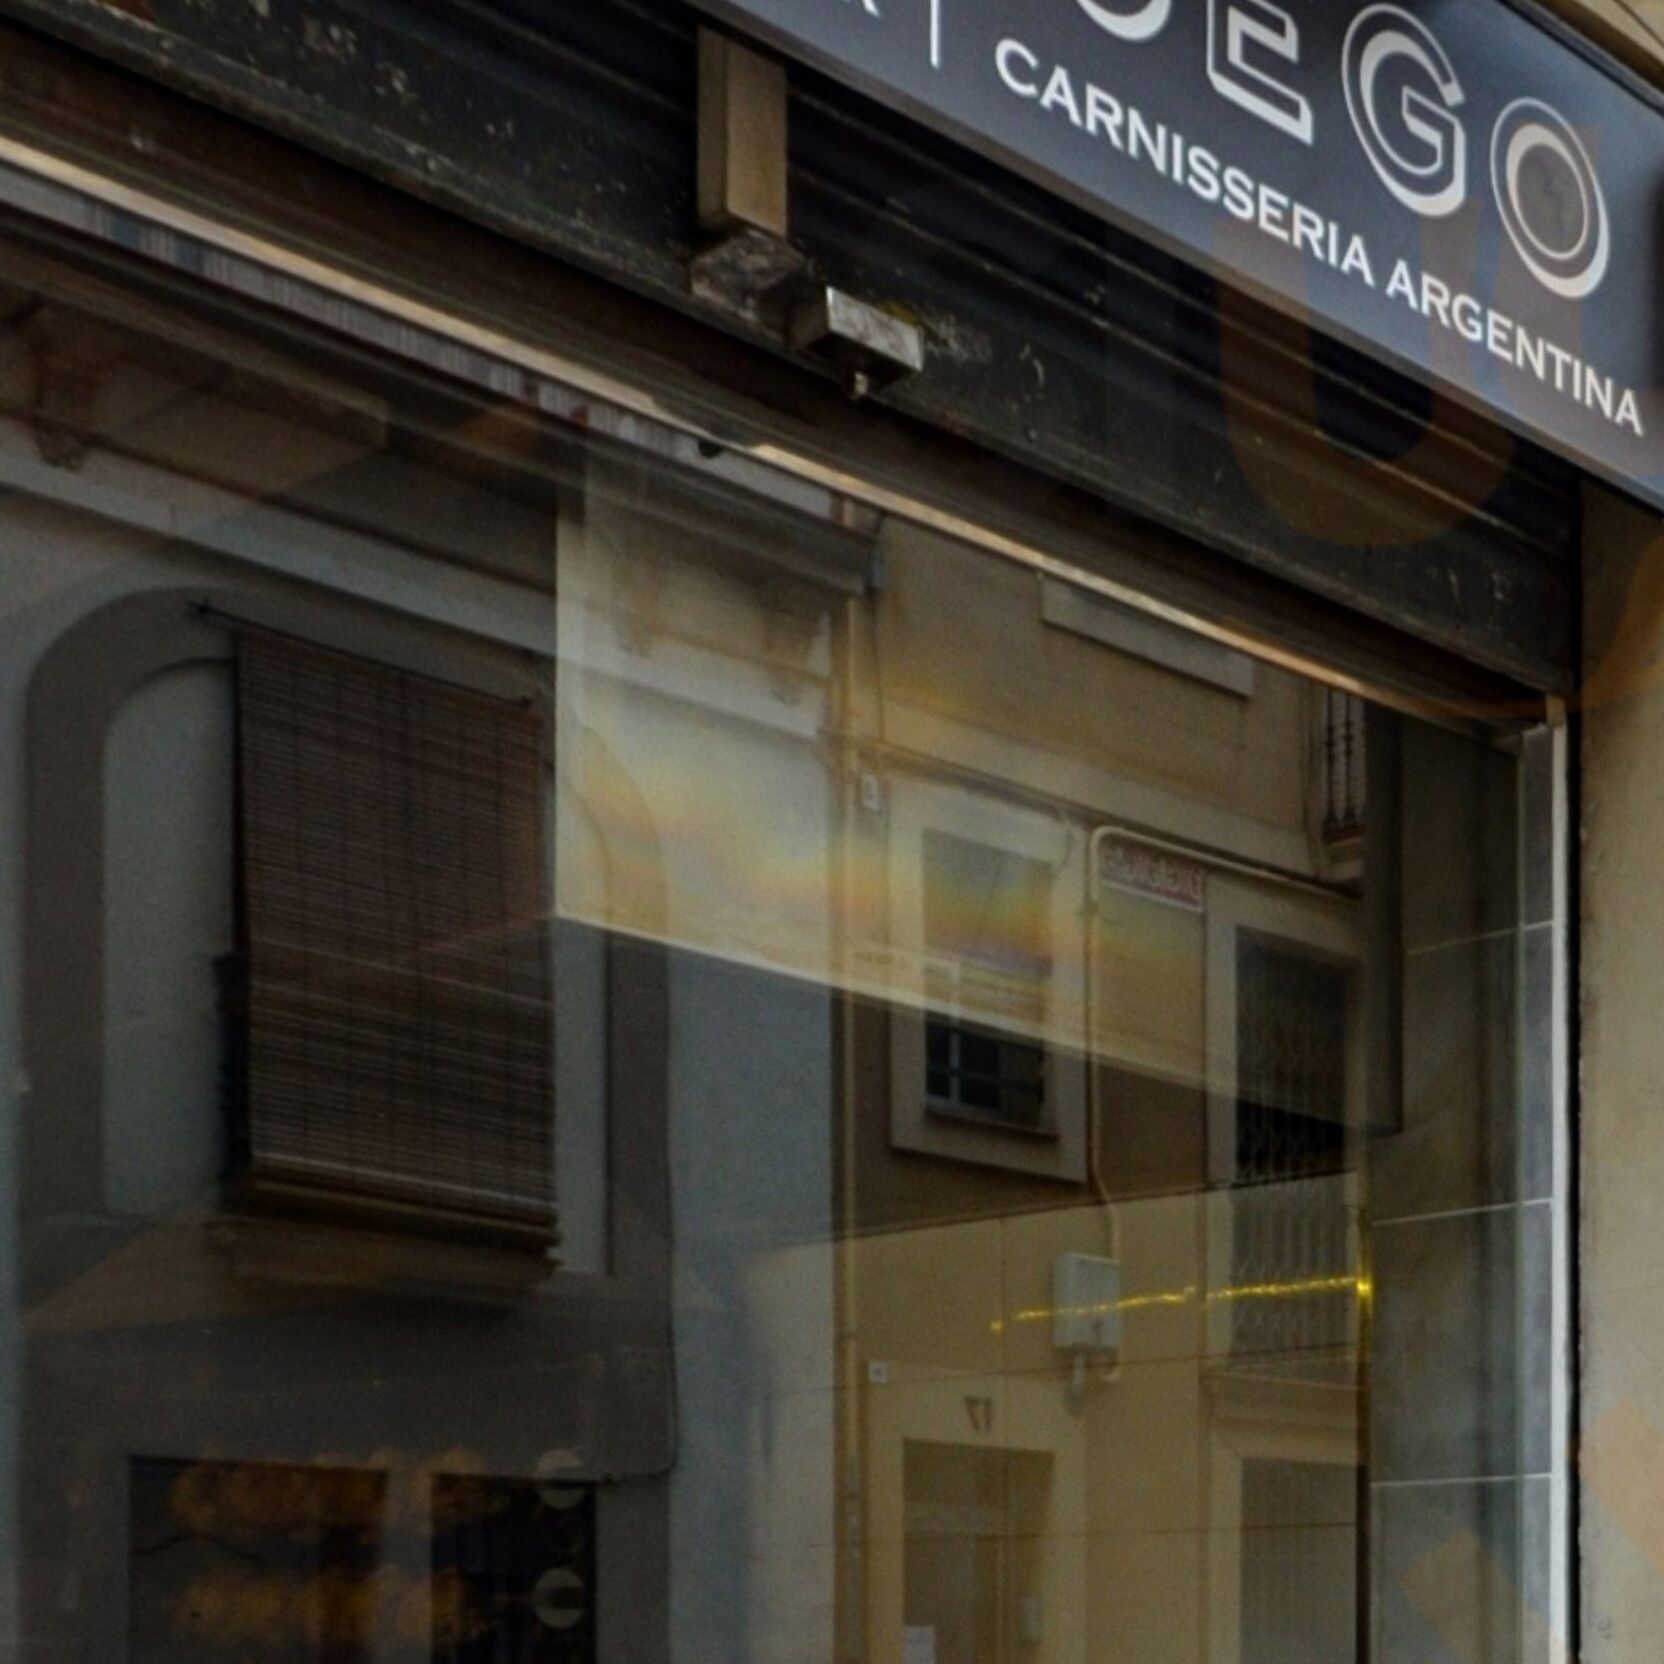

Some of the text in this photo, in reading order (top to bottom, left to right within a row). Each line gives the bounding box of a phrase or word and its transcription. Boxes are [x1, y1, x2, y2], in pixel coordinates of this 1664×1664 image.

[996, 38, 1375, 289] CARNISSERIA
[1386, 259, 1644, 437] ARGENTINA
[1076, 0, 1610, 298] EGO
